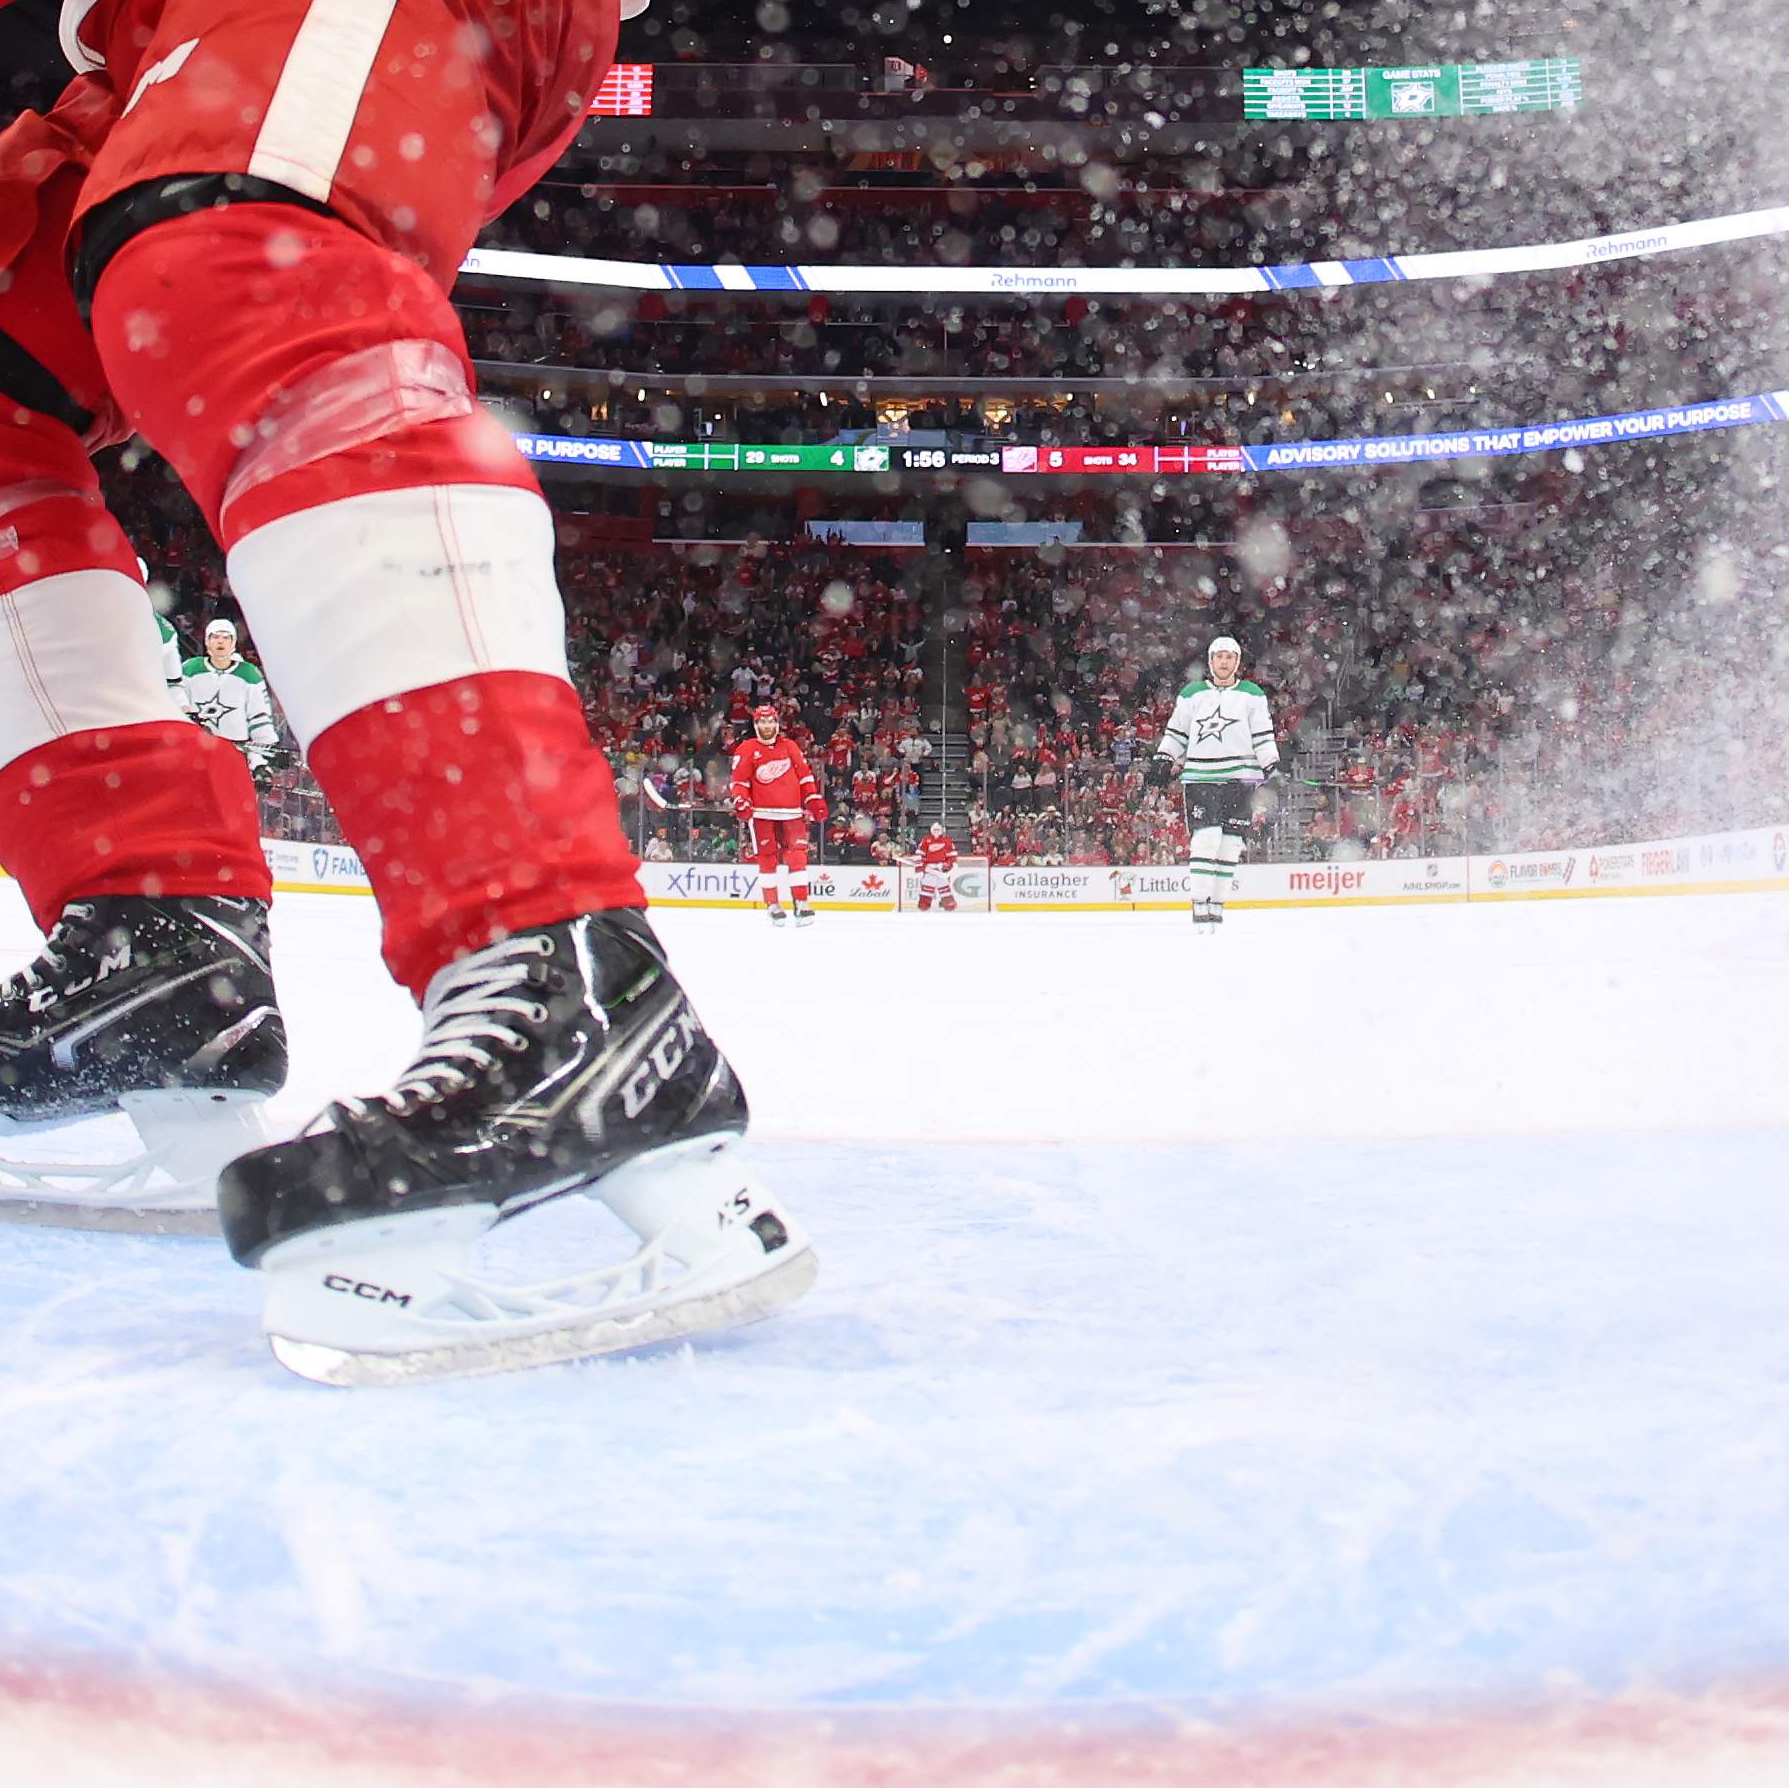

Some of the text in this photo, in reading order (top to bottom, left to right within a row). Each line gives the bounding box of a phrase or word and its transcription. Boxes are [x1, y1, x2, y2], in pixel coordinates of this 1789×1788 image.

[1586, 233, 1668, 258] Rehmann
[990, 270, 1078, 290] Rehmann
[1267, 401, 1752, 466] ADVISORY SOLUTIONS THAT EMPOWER YOUR PURPOSE
[535, 439, 621, 461] PURPOSE
[746, 452, 764, 464] 29
[830, 452, 844, 464] 4
[903, 452, 945, 468] 1:56
[952, 453, 999, 464] PERIOD 3
[1049, 453, 1062, 467] 5
[1118, 454, 1137, 466] 34
[667, 866, 759, 898] xfinity
[1002, 873, 1089, 889] Gallagher
[1139, 876, 1179, 893] Little
[1289, 866, 1364, 895] meijer
[849, 886, 890, 898] Labatt
[1015, 890, 1077, 899] INSURANCE
[620, 1002, 701, 1119] CCM
[322, 1272, 413, 1310] CCM
